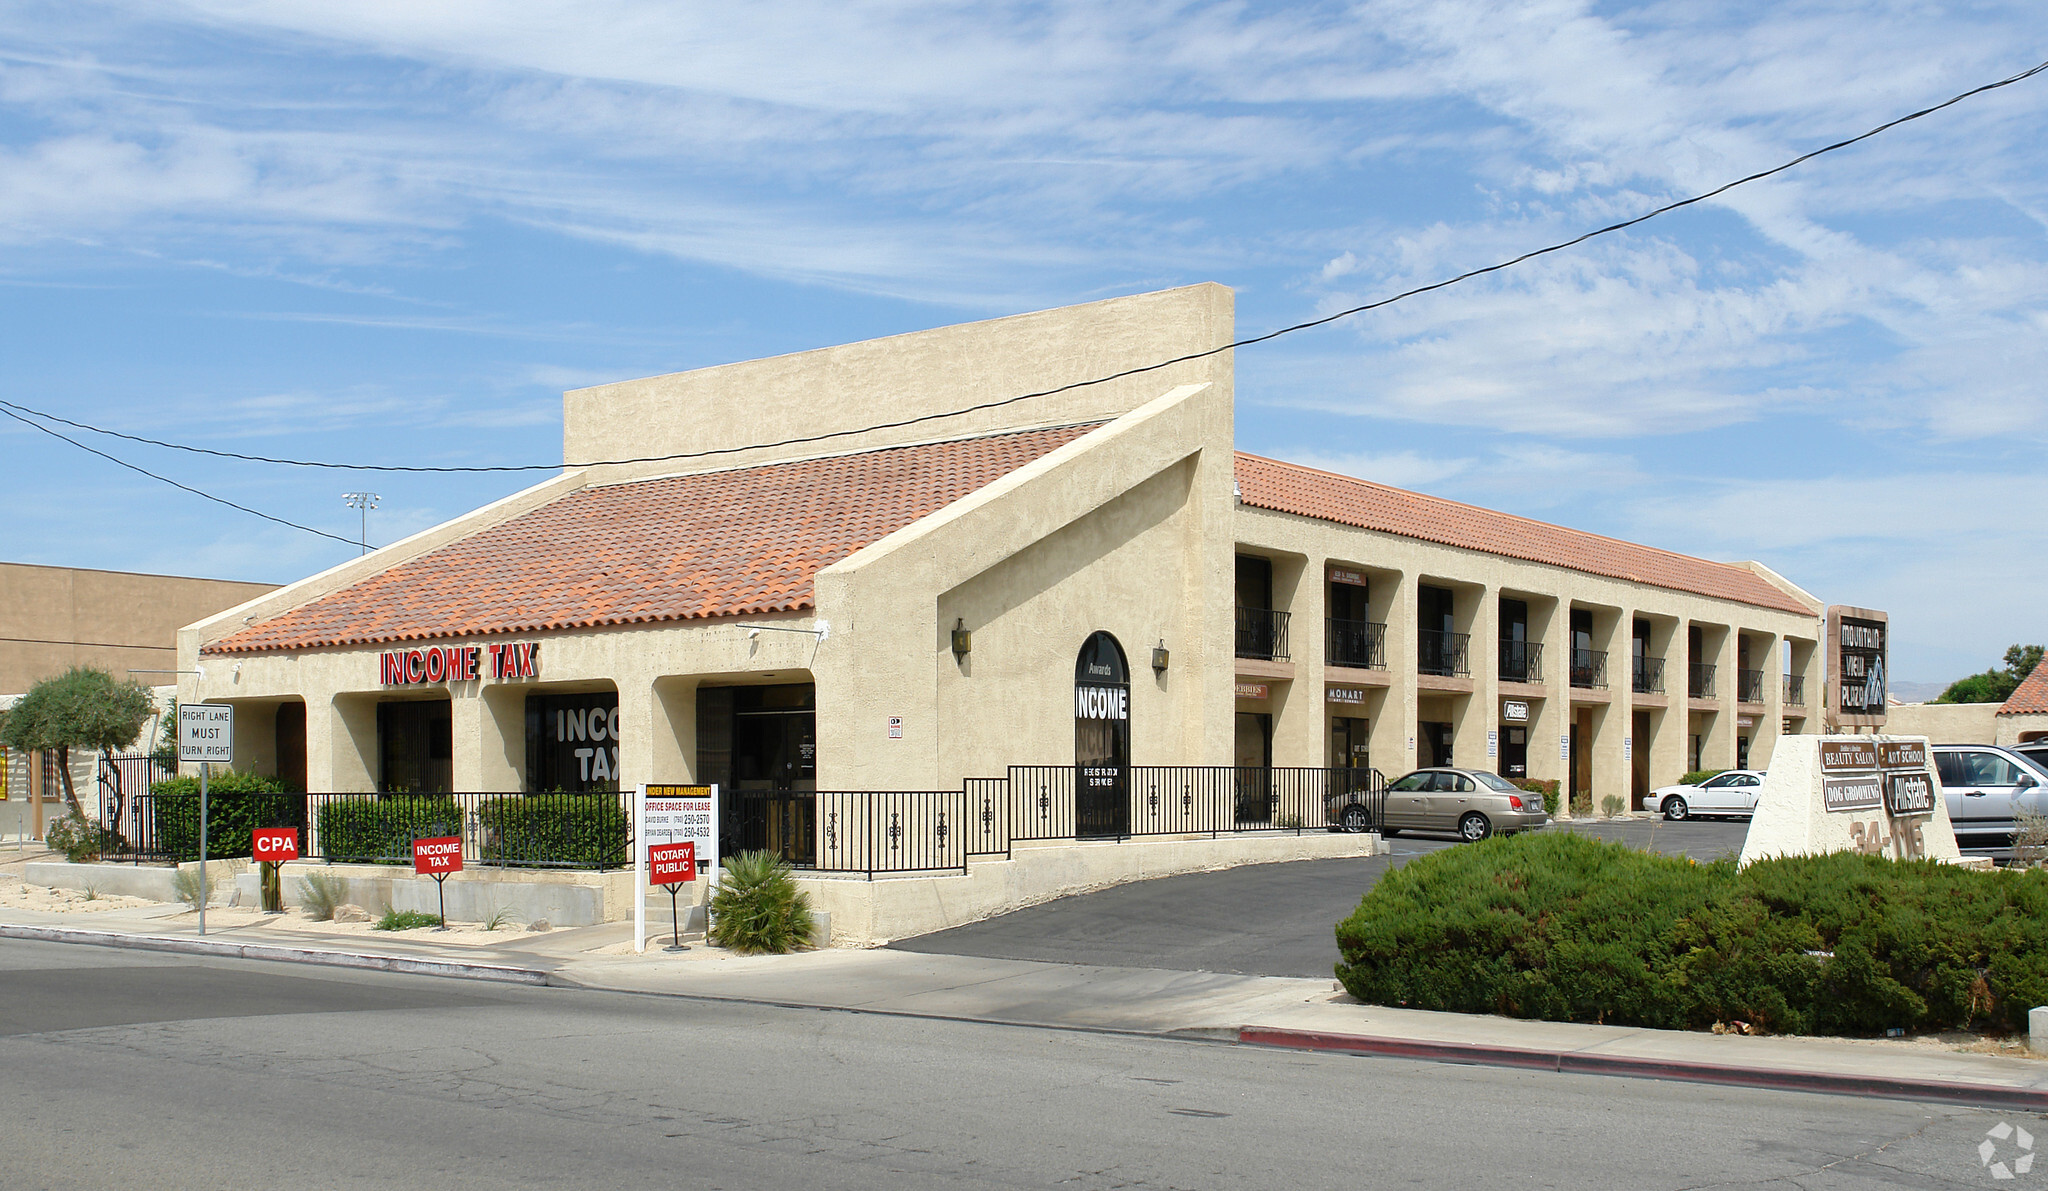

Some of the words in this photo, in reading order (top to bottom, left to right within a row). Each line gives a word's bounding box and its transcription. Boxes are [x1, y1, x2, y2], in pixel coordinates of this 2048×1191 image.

[1841, 624, 1880, 649] MOUNTAIN
[380, 647, 478, 685] INCOME
[489, 643, 536, 678] TAX
[1088, 662, 1111, 676] Awards
[1845, 655, 1865, 677] VIEW
[1329, 688, 1363, 700] MONART
[1841, 685, 1864, 707] PLAZA
[1075, 686, 1127, 720] INCOME
[182, 711, 206, 720] RIGHT
[209, 712, 229, 721] LANE
[1506, 704, 1527, 719] Allstate
[192, 728, 220, 739] MUST
[181, 746, 202, 755] TURN
[206, 746, 230, 755] RIGHT
[1888, 751, 1900, 764] ART
[1901, 750, 1924, 763] SCHOOL
[1825, 752, 1853, 766] BEAUTY
[1855, 752, 1875, 765] SALON
[663, 786, 675, 796] NEW
[675, 786, 711, 796] MANAGEMENT
[1827, 786, 1844, 803] DOG
[1844, 784, 1880, 801] GROOMING
[1895, 777, 1929, 811] Allstate
[645, 802, 664, 811] OFFICE
[665, 802, 682, 811] SPACE
[683, 802, 694, 811] FOR
[695, 802, 711, 811] LEASE
[684, 814, 710, 824] 250-2570
[684, 827, 710, 837] 250-4532
[257, 836, 295, 852] CPA
[416, 843, 460, 856] INCOME
[429, 856, 450, 867] TAX
[653, 848, 691, 862] NOTARY
[656, 861, 689, 875] PUBLIC
